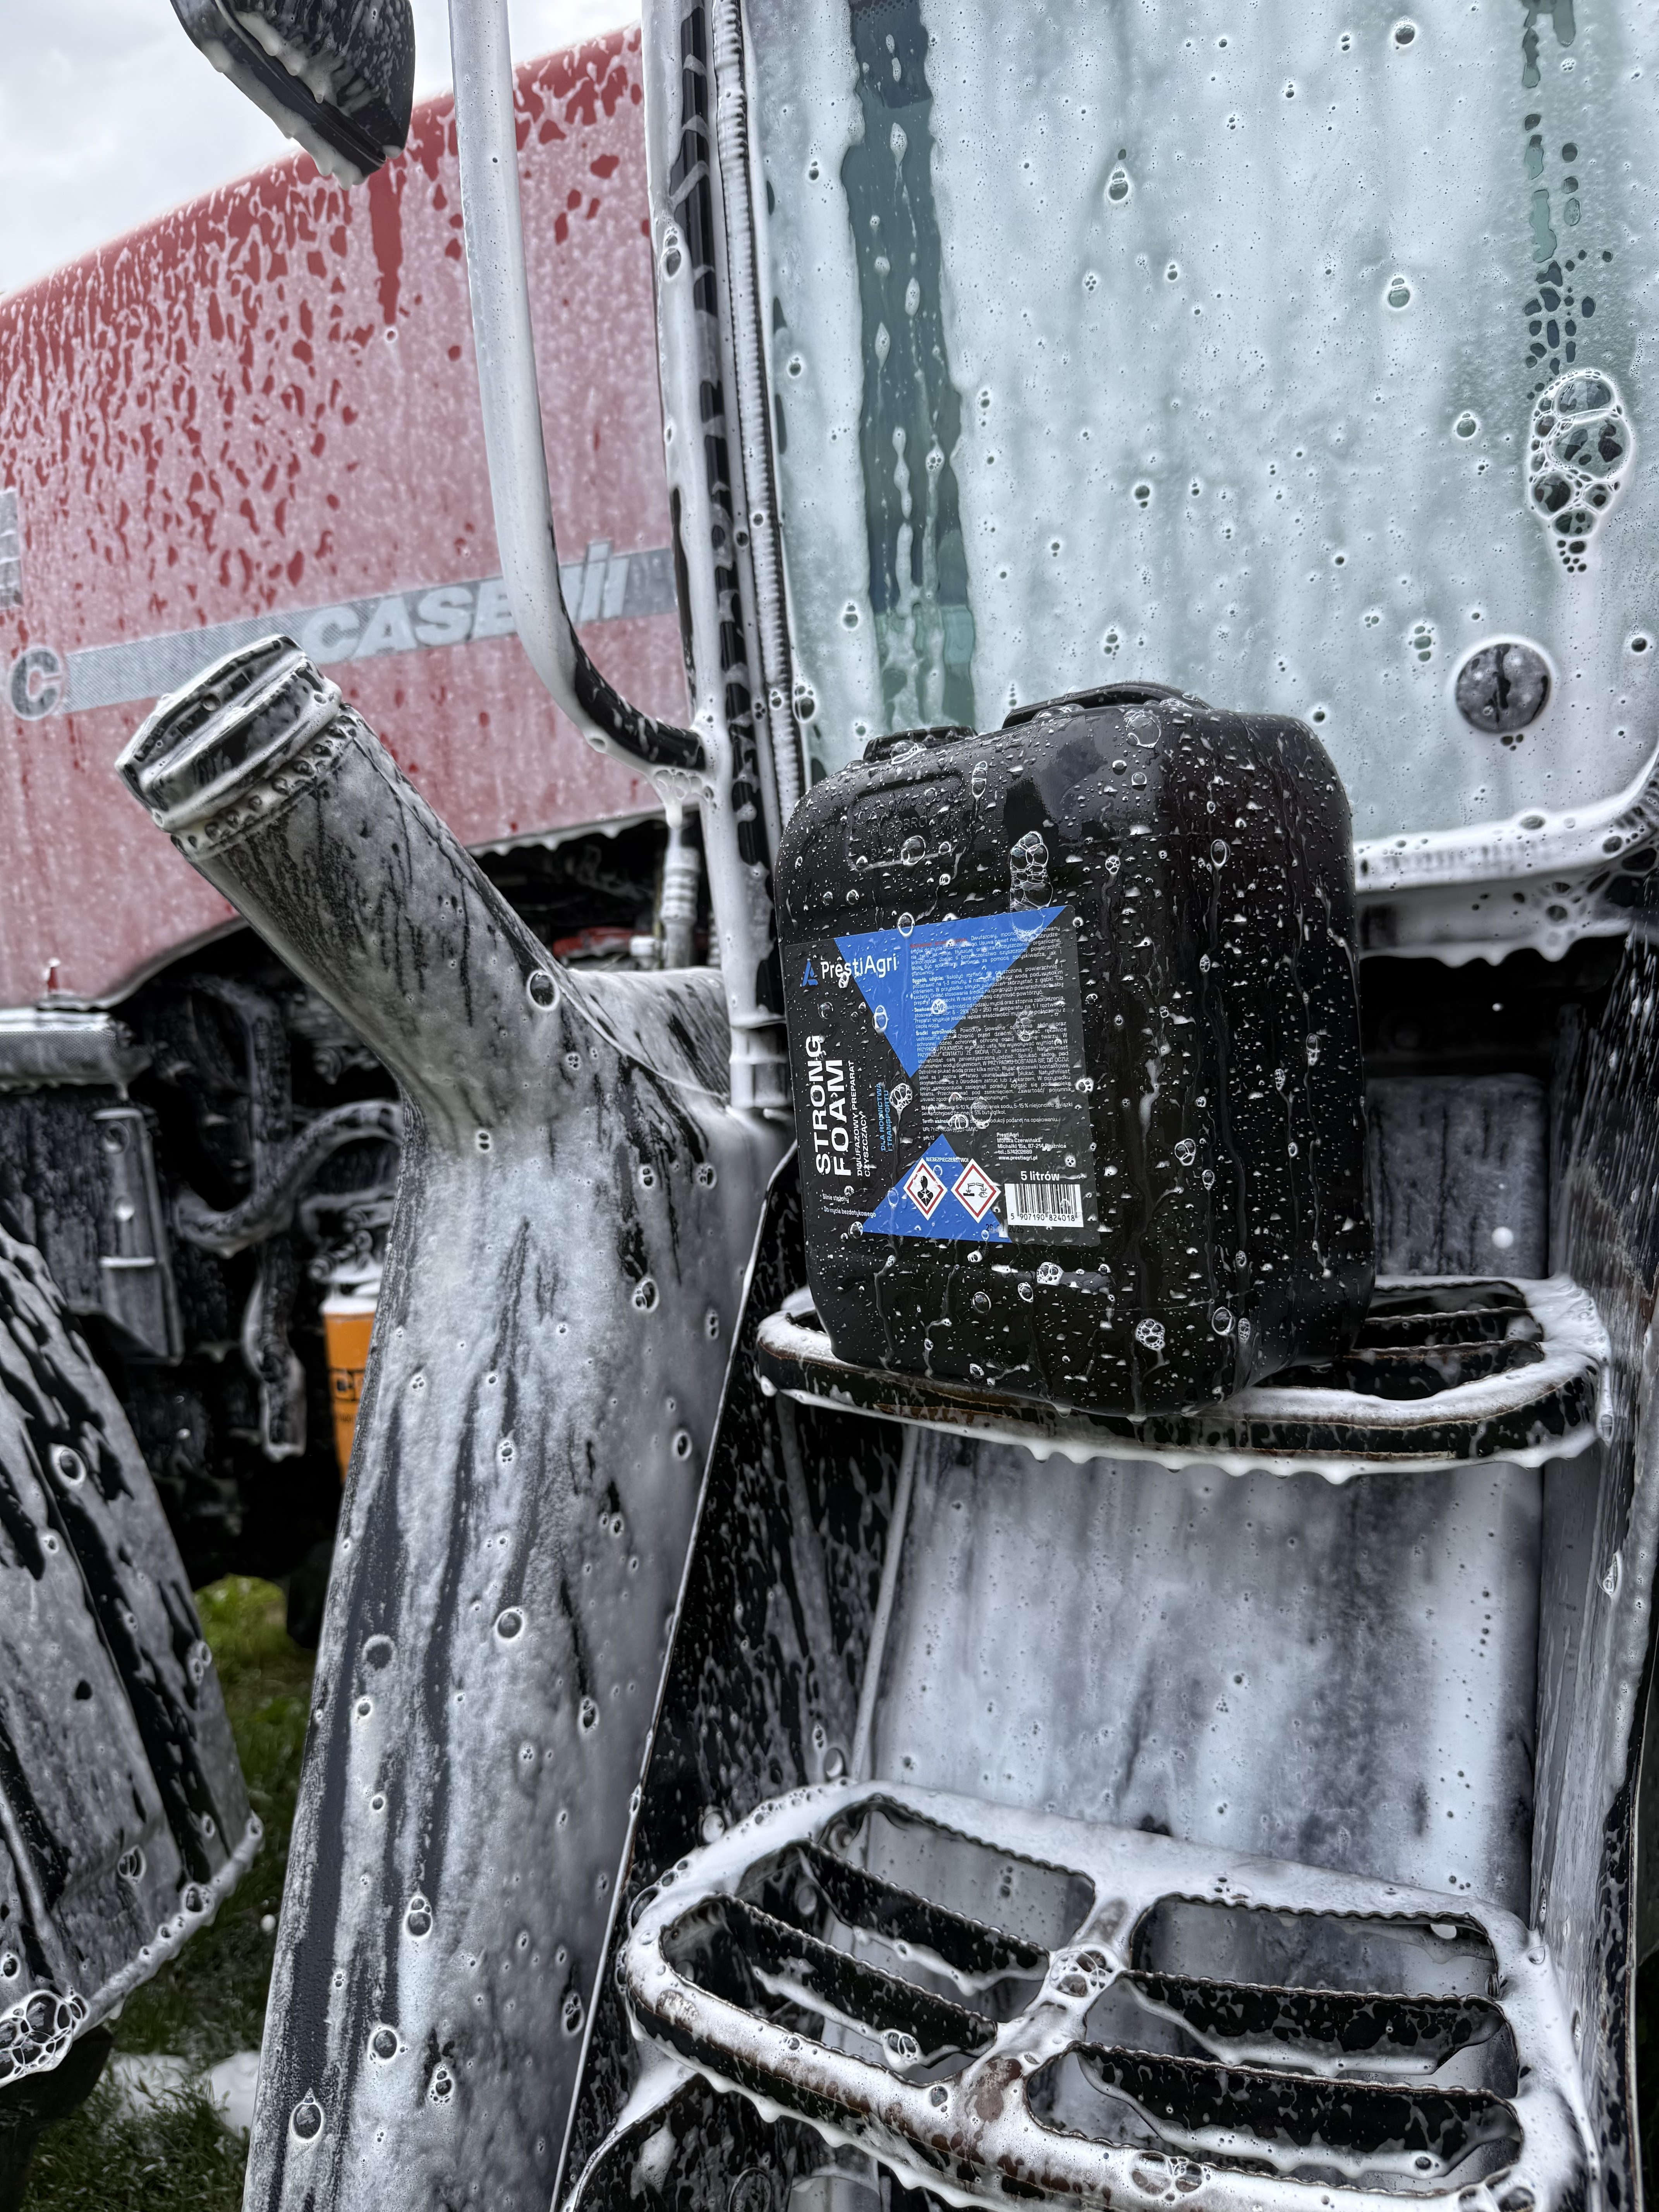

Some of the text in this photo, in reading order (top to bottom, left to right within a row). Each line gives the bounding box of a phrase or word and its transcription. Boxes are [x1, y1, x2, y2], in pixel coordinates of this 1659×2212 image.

[302, 577, 516, 665] CASE
[820, 953, 897, 979] PrestiAgri
[1017, 989, 1043, 997] powtórzyć.
[805, 1035, 831, 1175] STRONG
[826, 1060, 851, 1176] FOAM
[848, 1060, 863, 1177] DWUFAZOWY PREPARAT
[884, 1091, 892, 1147] TRANSPORTU
[1020, 1171, 1060, 1181] 5 litrów
[841, 1208, 876, 1218] bezdotykowego
[1019, 1213, 1044, 1221] 907190
[1049, 1214, 1075, 1222] 824018
